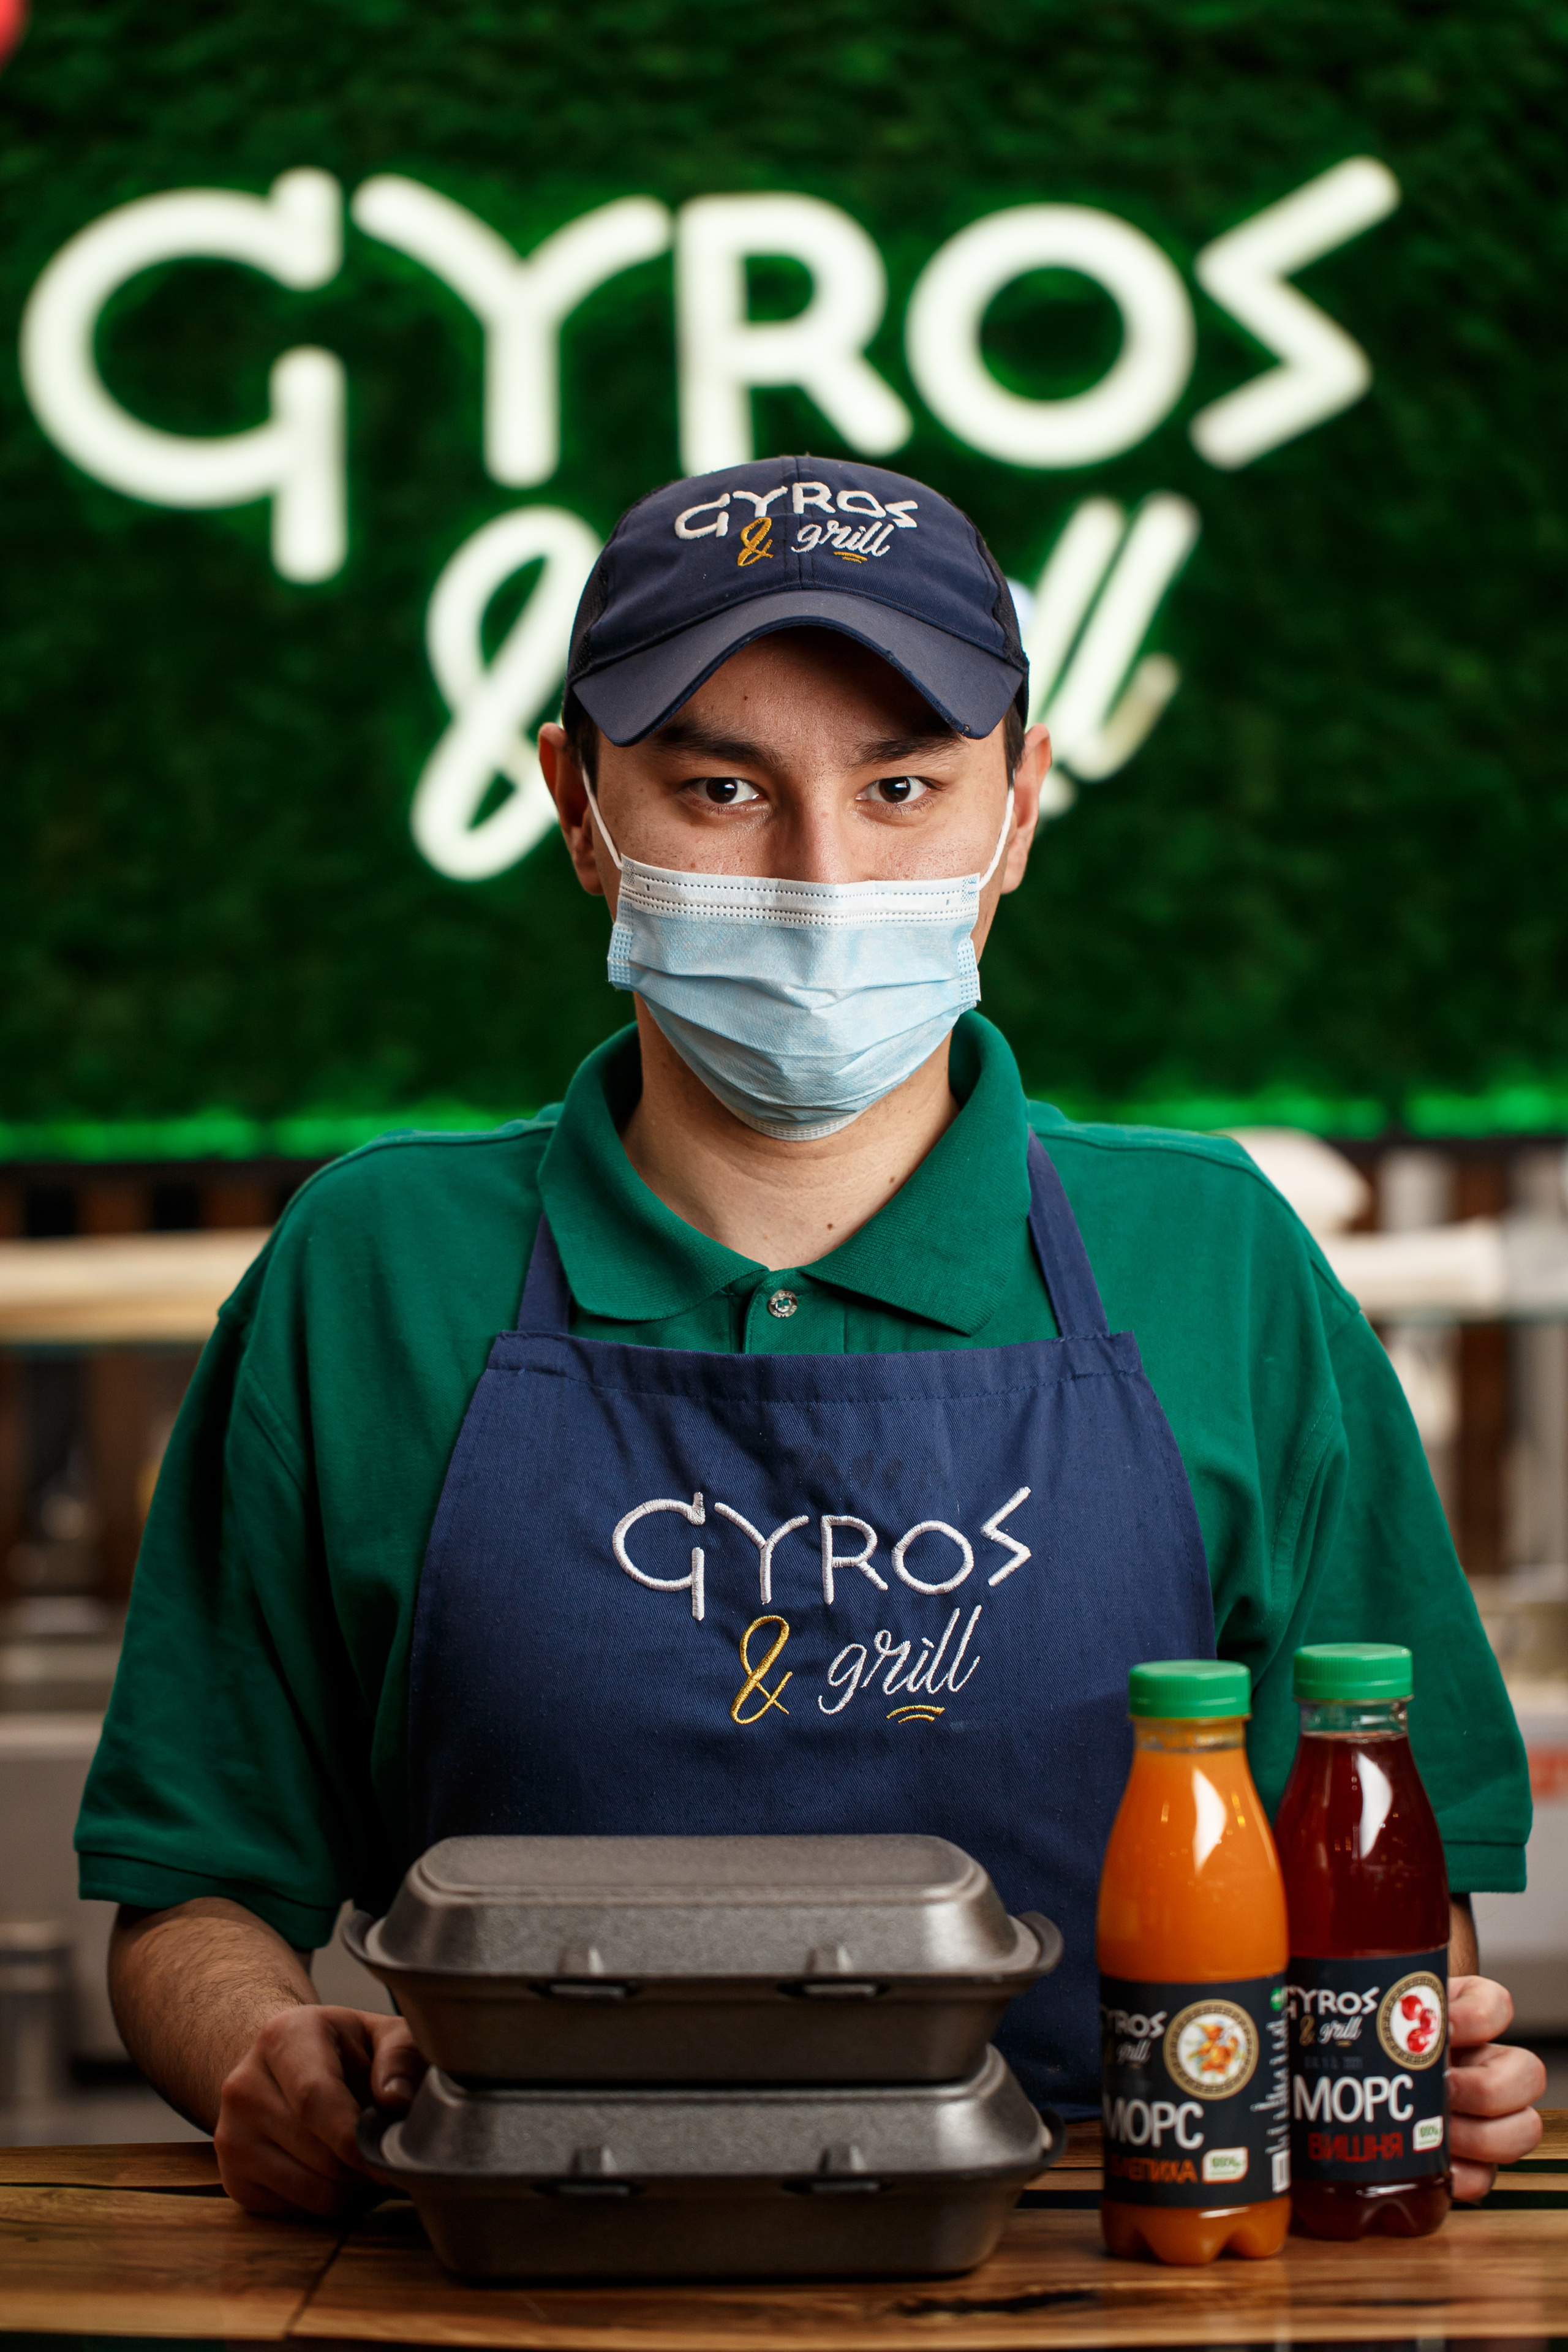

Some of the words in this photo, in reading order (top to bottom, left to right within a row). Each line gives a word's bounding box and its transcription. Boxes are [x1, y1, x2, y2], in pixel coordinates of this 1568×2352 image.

[22, 156, 1401, 583] GYROS
[674, 481, 918, 540] GYROS
[737, 517, 774, 567] &
[791, 519, 894, 557] grill
[612, 1486, 1031, 1621] GYROS
[731, 1615, 793, 1724] &
[818, 1605, 982, 1715] grill
[1100, 2003, 1168, 2040] YROS
[1298, 2015, 1316, 2047] &
[1318, 2015, 1363, 2045] grill
[1293, 2073, 1414, 2124] МОРС
[1307, 2131, 1404, 2163] ВИШНЯ
